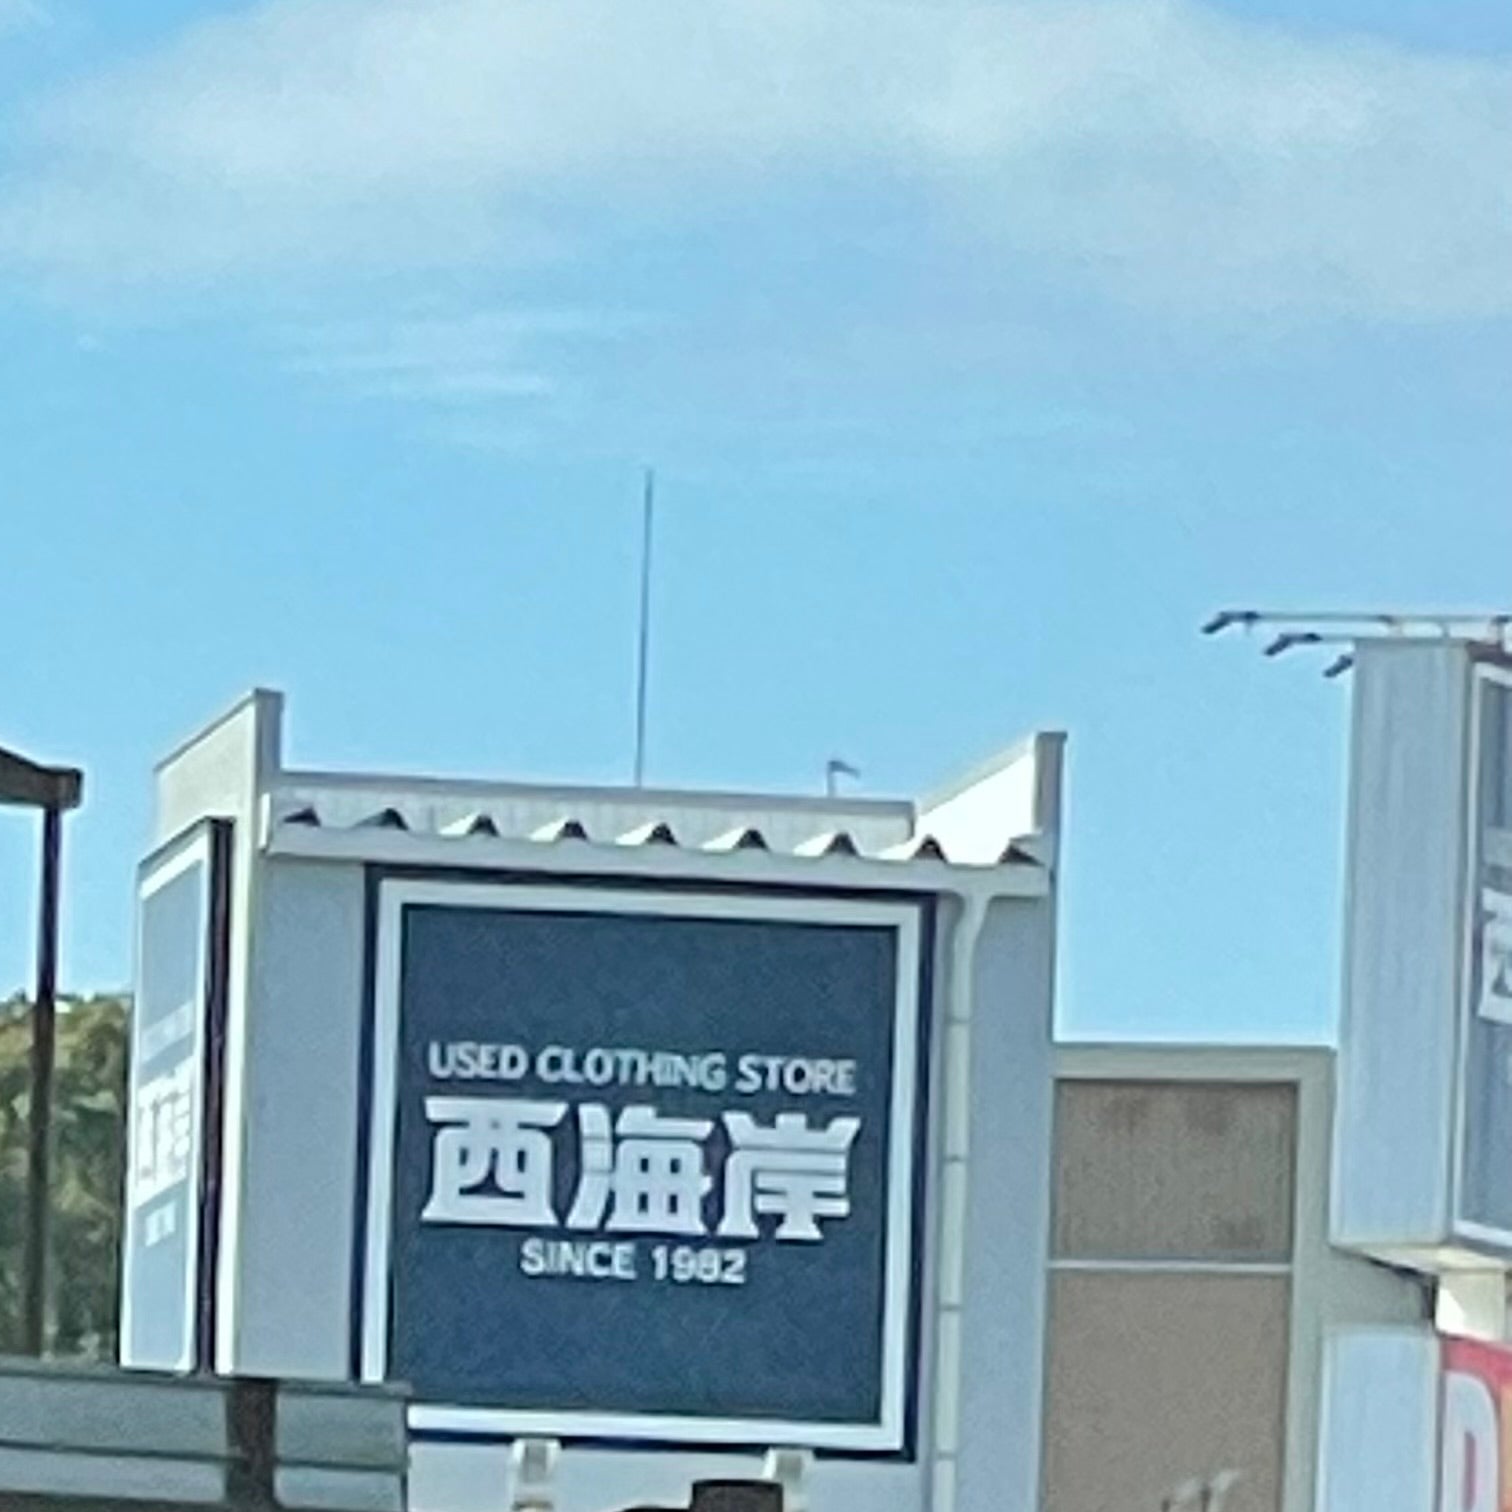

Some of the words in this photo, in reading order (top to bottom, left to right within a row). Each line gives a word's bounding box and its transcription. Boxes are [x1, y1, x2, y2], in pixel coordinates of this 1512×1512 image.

[428, 1041, 529, 1080] USED
[536, 1045, 727, 1091] CLOTHING
[735, 1053, 857, 1096] STORE
[420, 1096, 861, 1240] 西海岸
[520, 1237, 637, 1280] SINCE
[651, 1244, 747, 1284] 1982
